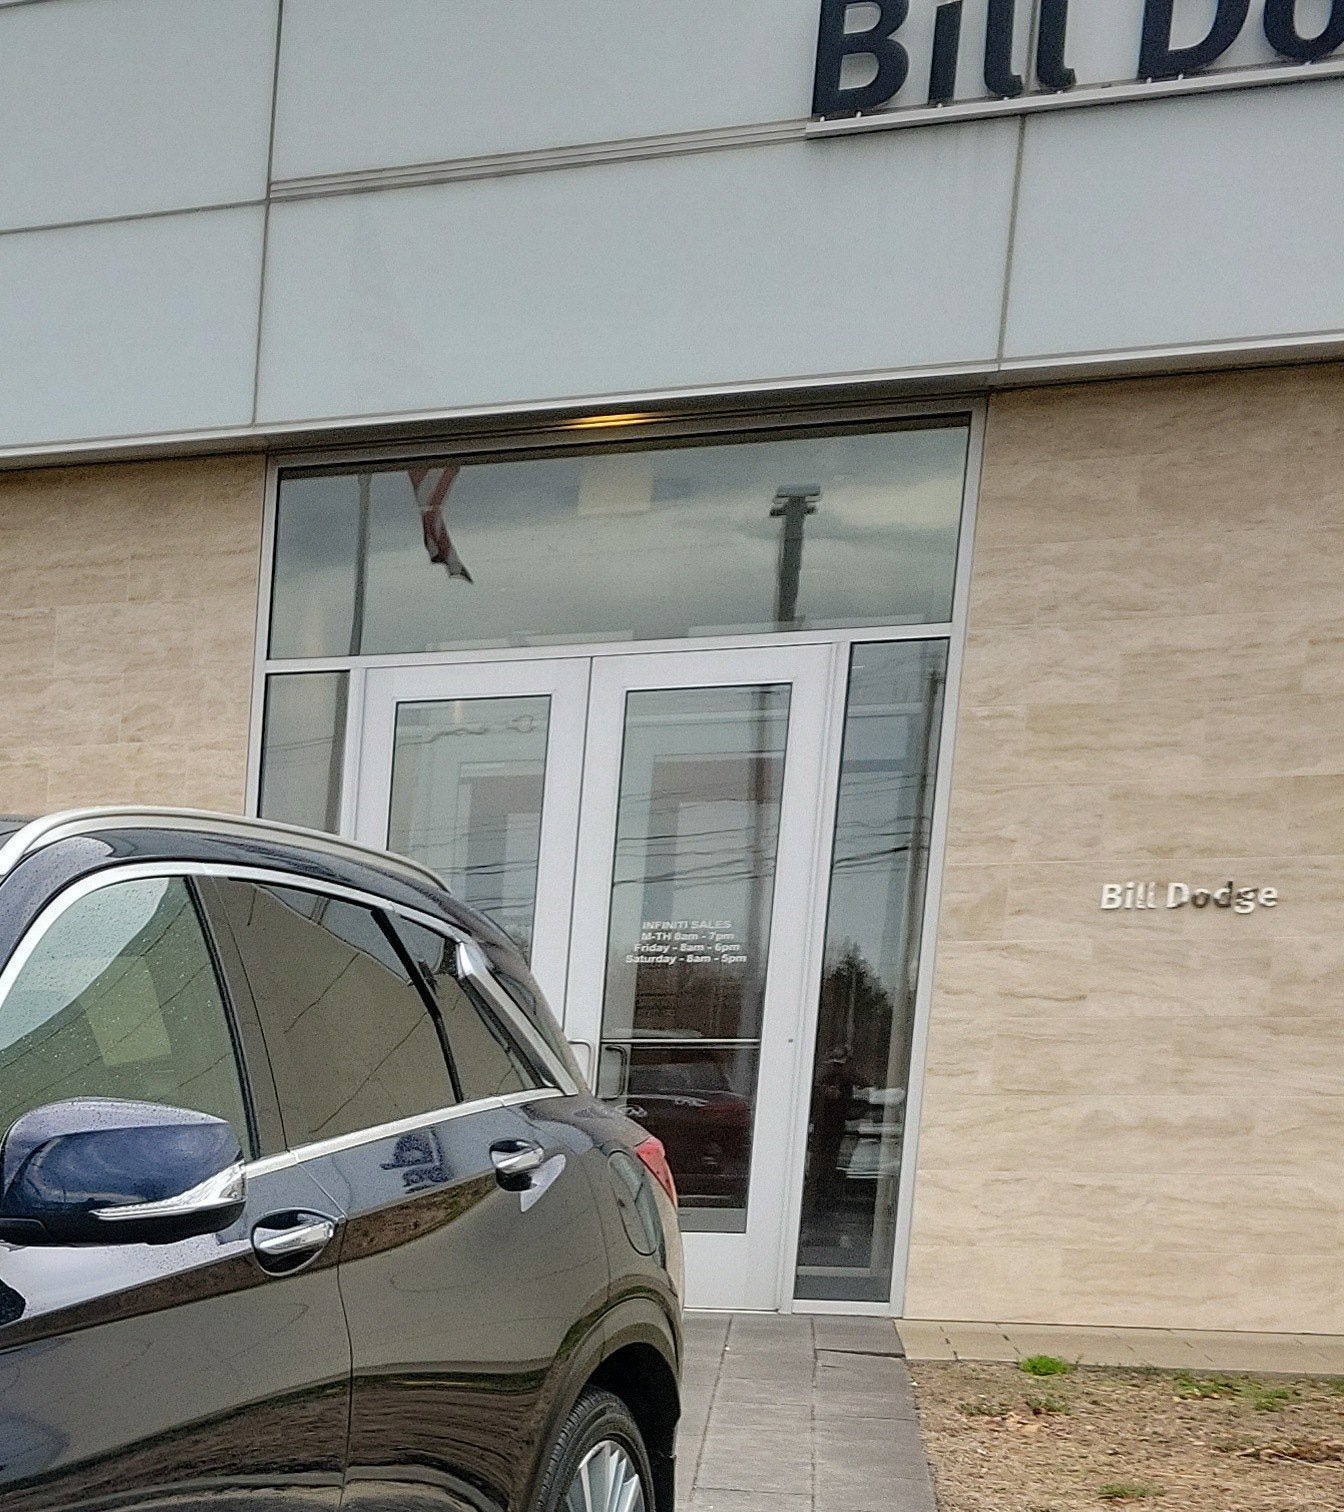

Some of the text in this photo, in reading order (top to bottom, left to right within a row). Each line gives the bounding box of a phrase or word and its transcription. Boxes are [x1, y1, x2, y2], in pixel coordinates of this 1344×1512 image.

[811, 0, 1077, 117] Bill
[1100, 880, 1279, 914] Bill Dodge
[642, 920, 732, 930] INFINITI SALES
[641, 932, 672, 941] M-TH
[634, 943, 670, 954] Friday
[625, 954, 677, 965] Saturday
